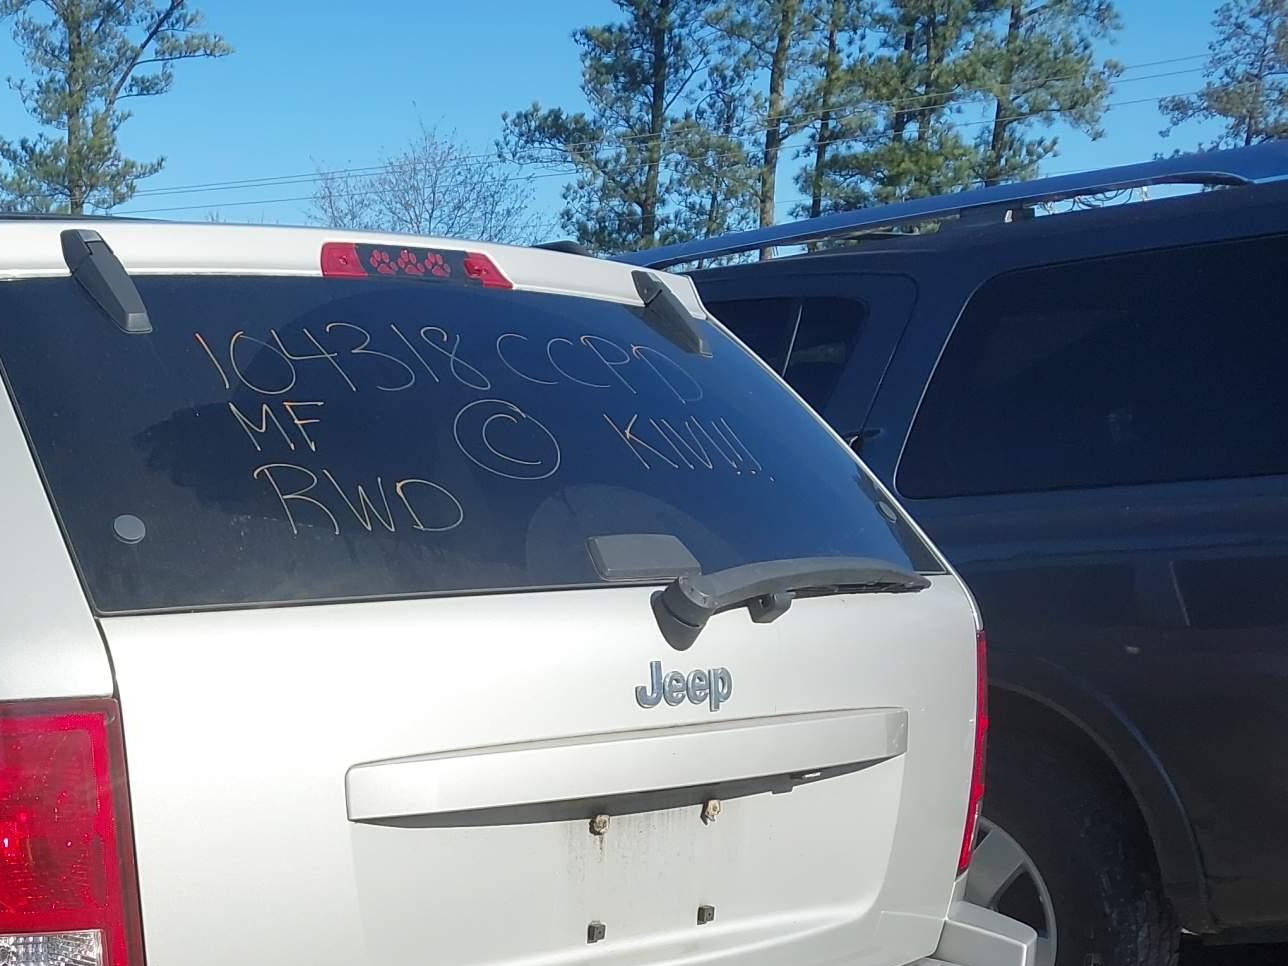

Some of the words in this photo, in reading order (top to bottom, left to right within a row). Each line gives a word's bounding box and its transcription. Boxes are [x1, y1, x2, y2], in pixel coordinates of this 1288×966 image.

[227, 400, 326, 453] MF
[252, 462, 465, 535] RWD
[634, 660, 733, 713] Jeep
